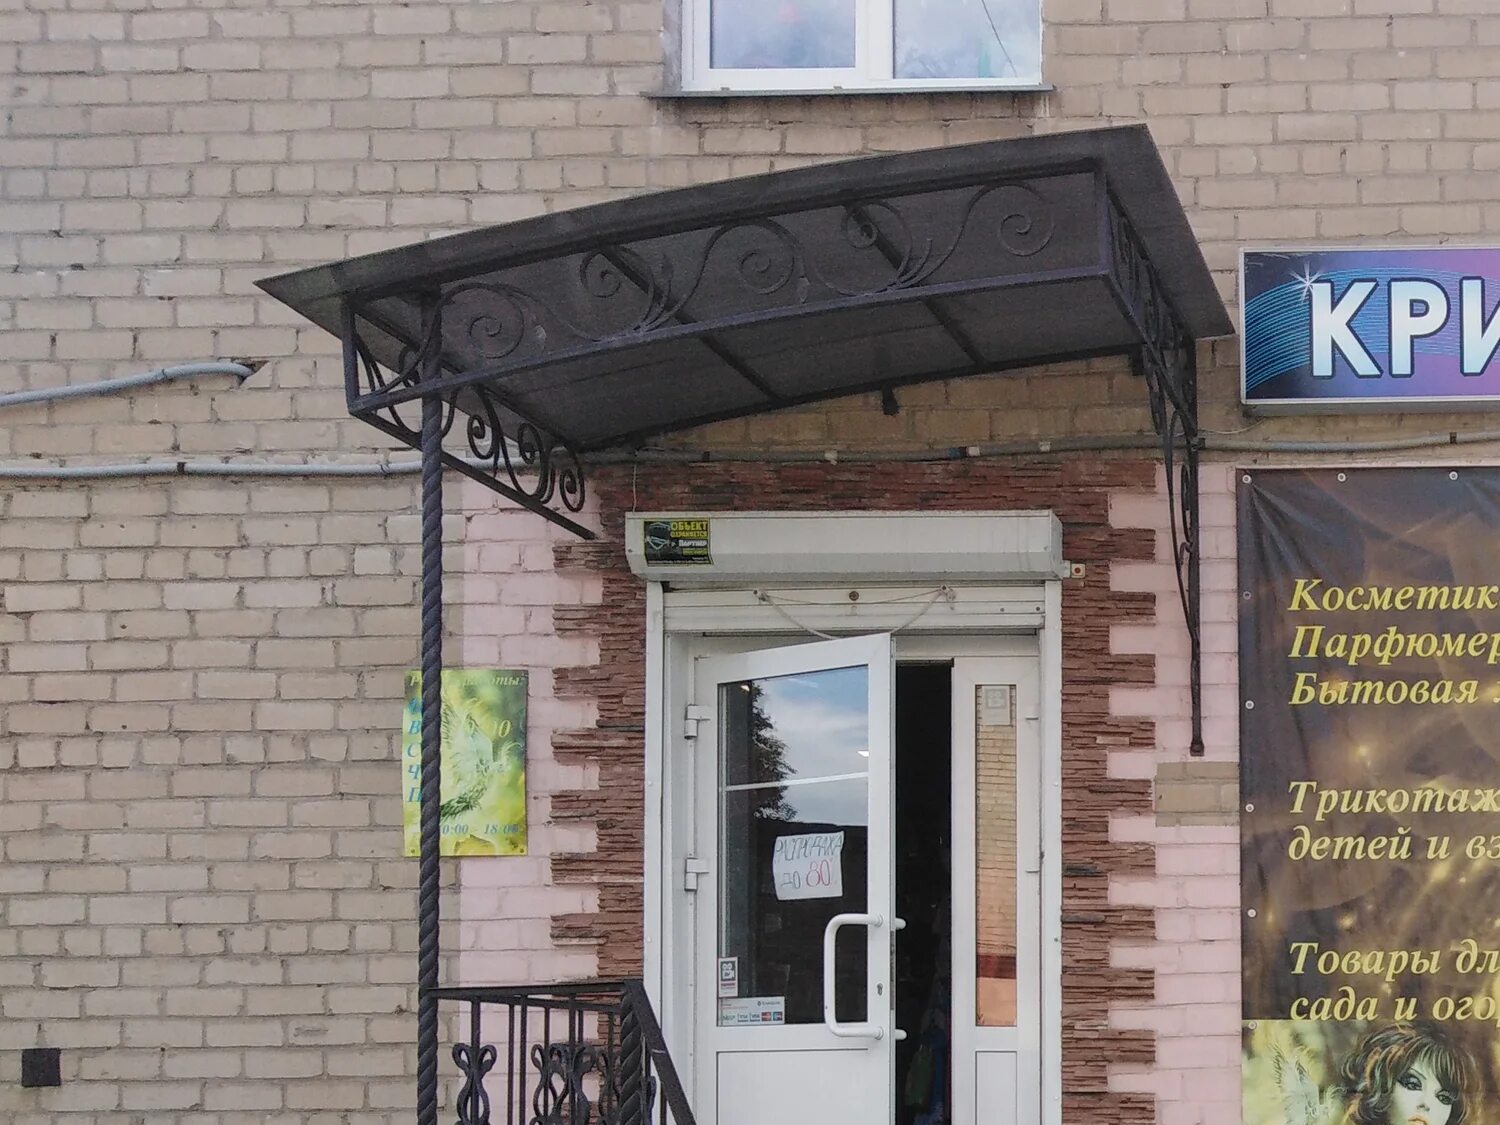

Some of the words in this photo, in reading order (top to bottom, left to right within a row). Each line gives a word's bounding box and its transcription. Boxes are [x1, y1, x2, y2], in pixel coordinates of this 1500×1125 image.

[1288, 671, 1478, 706] Бытовая
[1288, 825, 1412, 861] детей
[1426, 834, 1451, 860] и
[1289, 942, 1441, 982] Товары
[1290, 986, 1379, 1021] сада
[1394, 997, 1418, 1021] и
